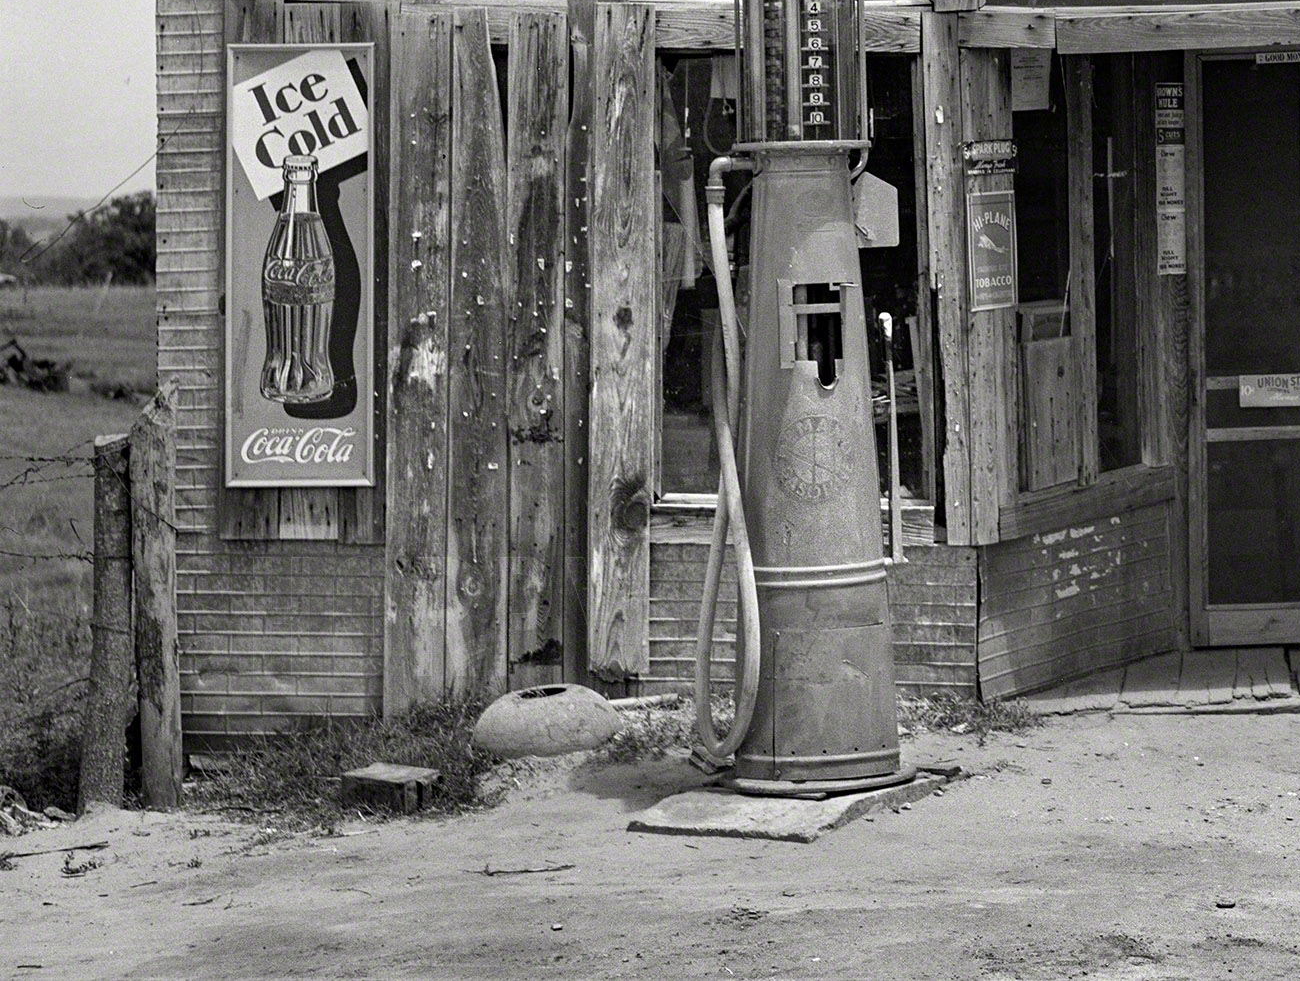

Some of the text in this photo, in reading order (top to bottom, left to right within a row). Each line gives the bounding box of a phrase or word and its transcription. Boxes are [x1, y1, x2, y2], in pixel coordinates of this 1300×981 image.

[810, 2, 818, 12] 4
[811, 21, 819, 30] 5
[811, 39, 819, 48] 6
[811, 58, 819, 67] 7
[1265, 53, 1285, 62] GOOD
[812, 76, 820, 85] 8
[248, 73, 329, 126] Ice
[812, 94, 820, 104] 9
[811, 113, 823, 124] 10
[255, 96, 362, 169] Cold
[1158, 129, 1165, 143] 5
[972, 142, 993, 155] SPARK
[994, 141, 1010, 154] PLUG
[972, 211, 1012, 233] HI-PLANE
[976, 275, 1012, 288] TOBACCO
[1257, 377, 1289, 388] UNION
[241, 427, 356, 463] Coca-Cola
